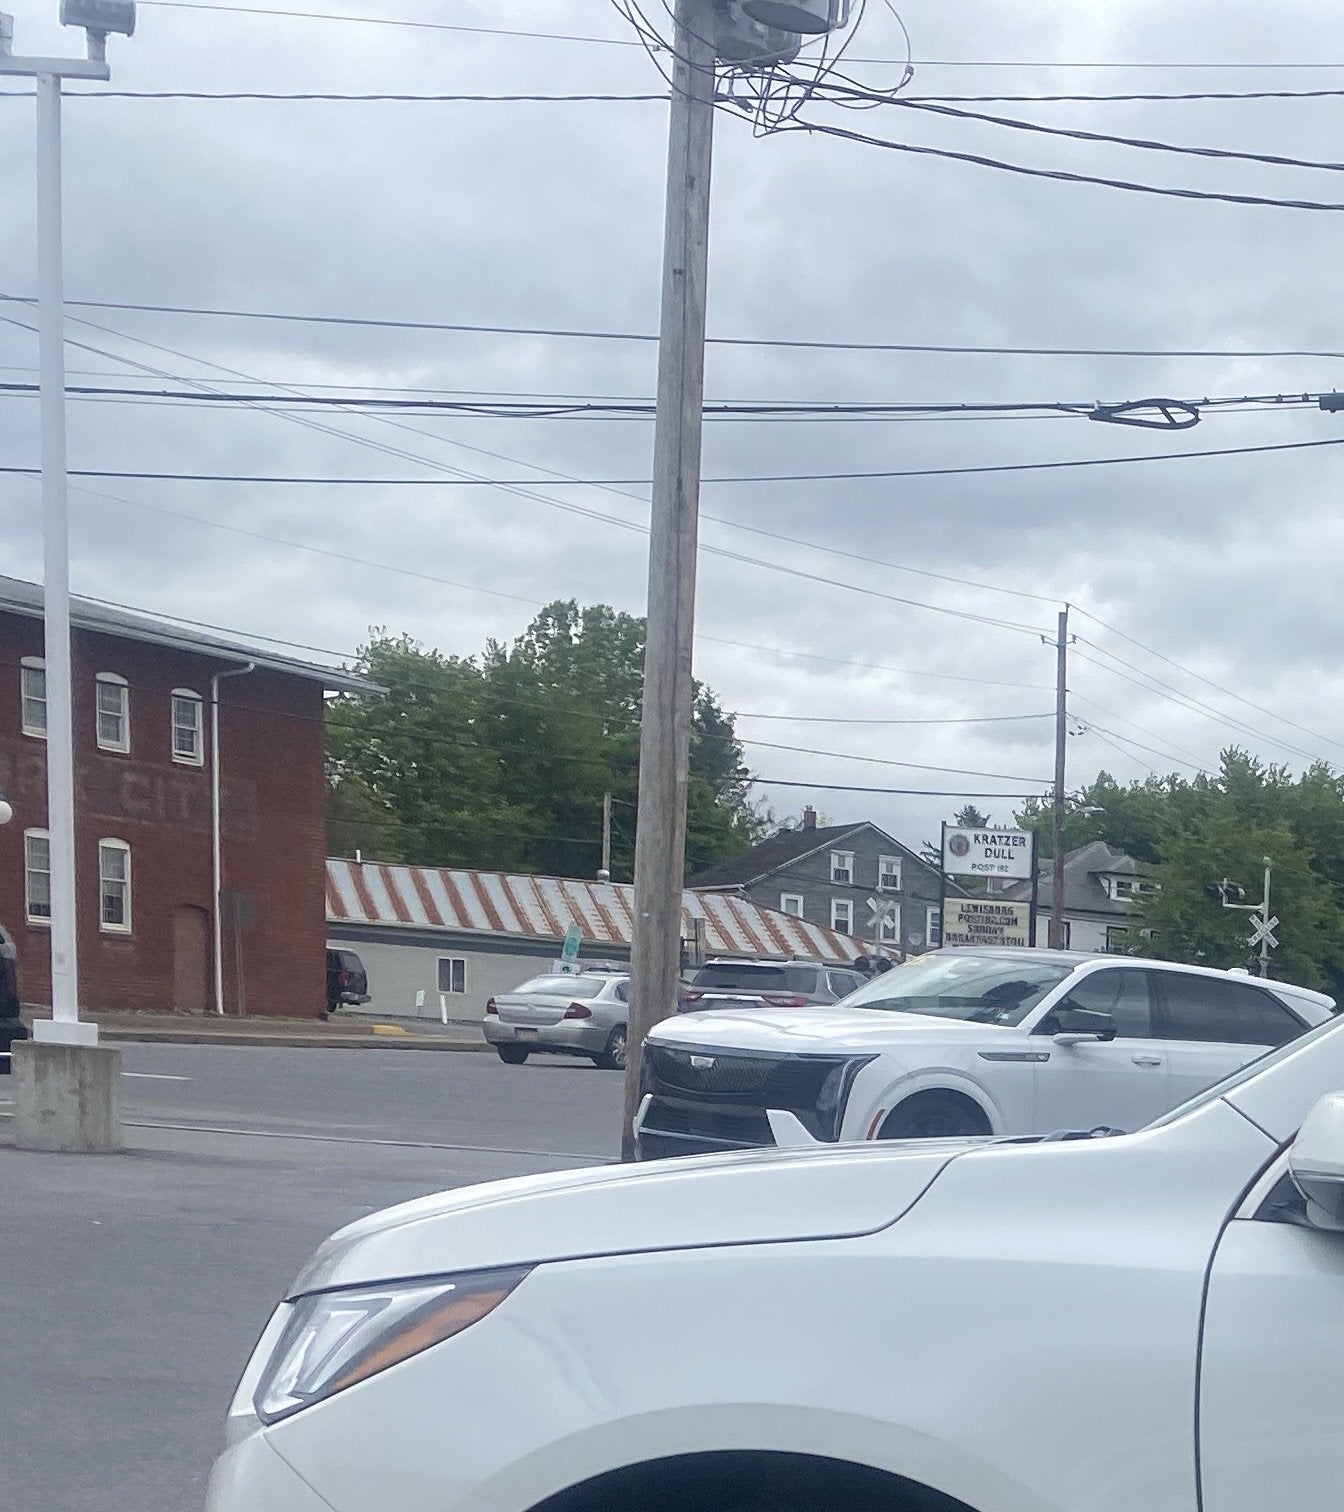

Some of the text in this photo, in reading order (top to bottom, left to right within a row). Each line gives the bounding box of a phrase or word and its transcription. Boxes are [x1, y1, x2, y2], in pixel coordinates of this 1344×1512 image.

[974, 834, 1026, 847] KRATZER
[985, 848, 1014, 860] DULL
[972, 863, 995, 872] POST
